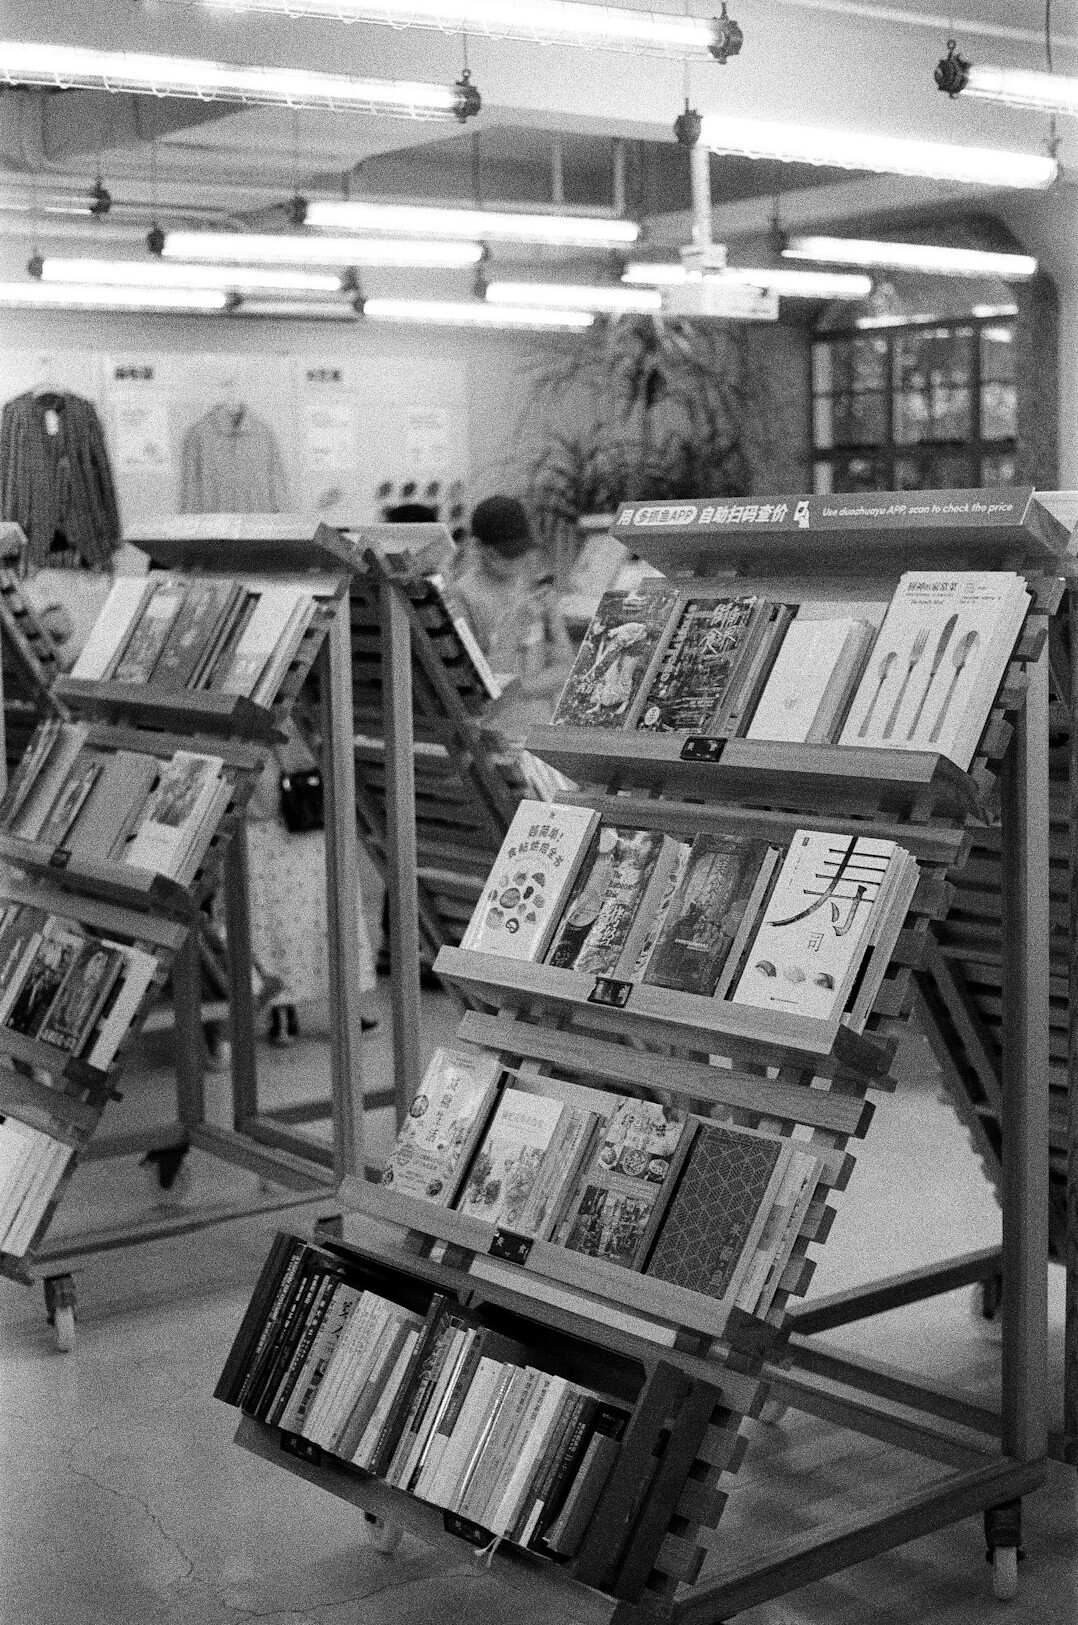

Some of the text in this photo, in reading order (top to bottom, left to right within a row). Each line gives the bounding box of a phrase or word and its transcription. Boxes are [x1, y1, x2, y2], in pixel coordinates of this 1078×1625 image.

[822, 507, 837, 516] Use
[908, 505, 930, 514] scan
[931, 503, 941, 513] to
[942, 502, 969, 513] check
[971, 502, 987, 513] the
[987, 501, 1013, 514] price
